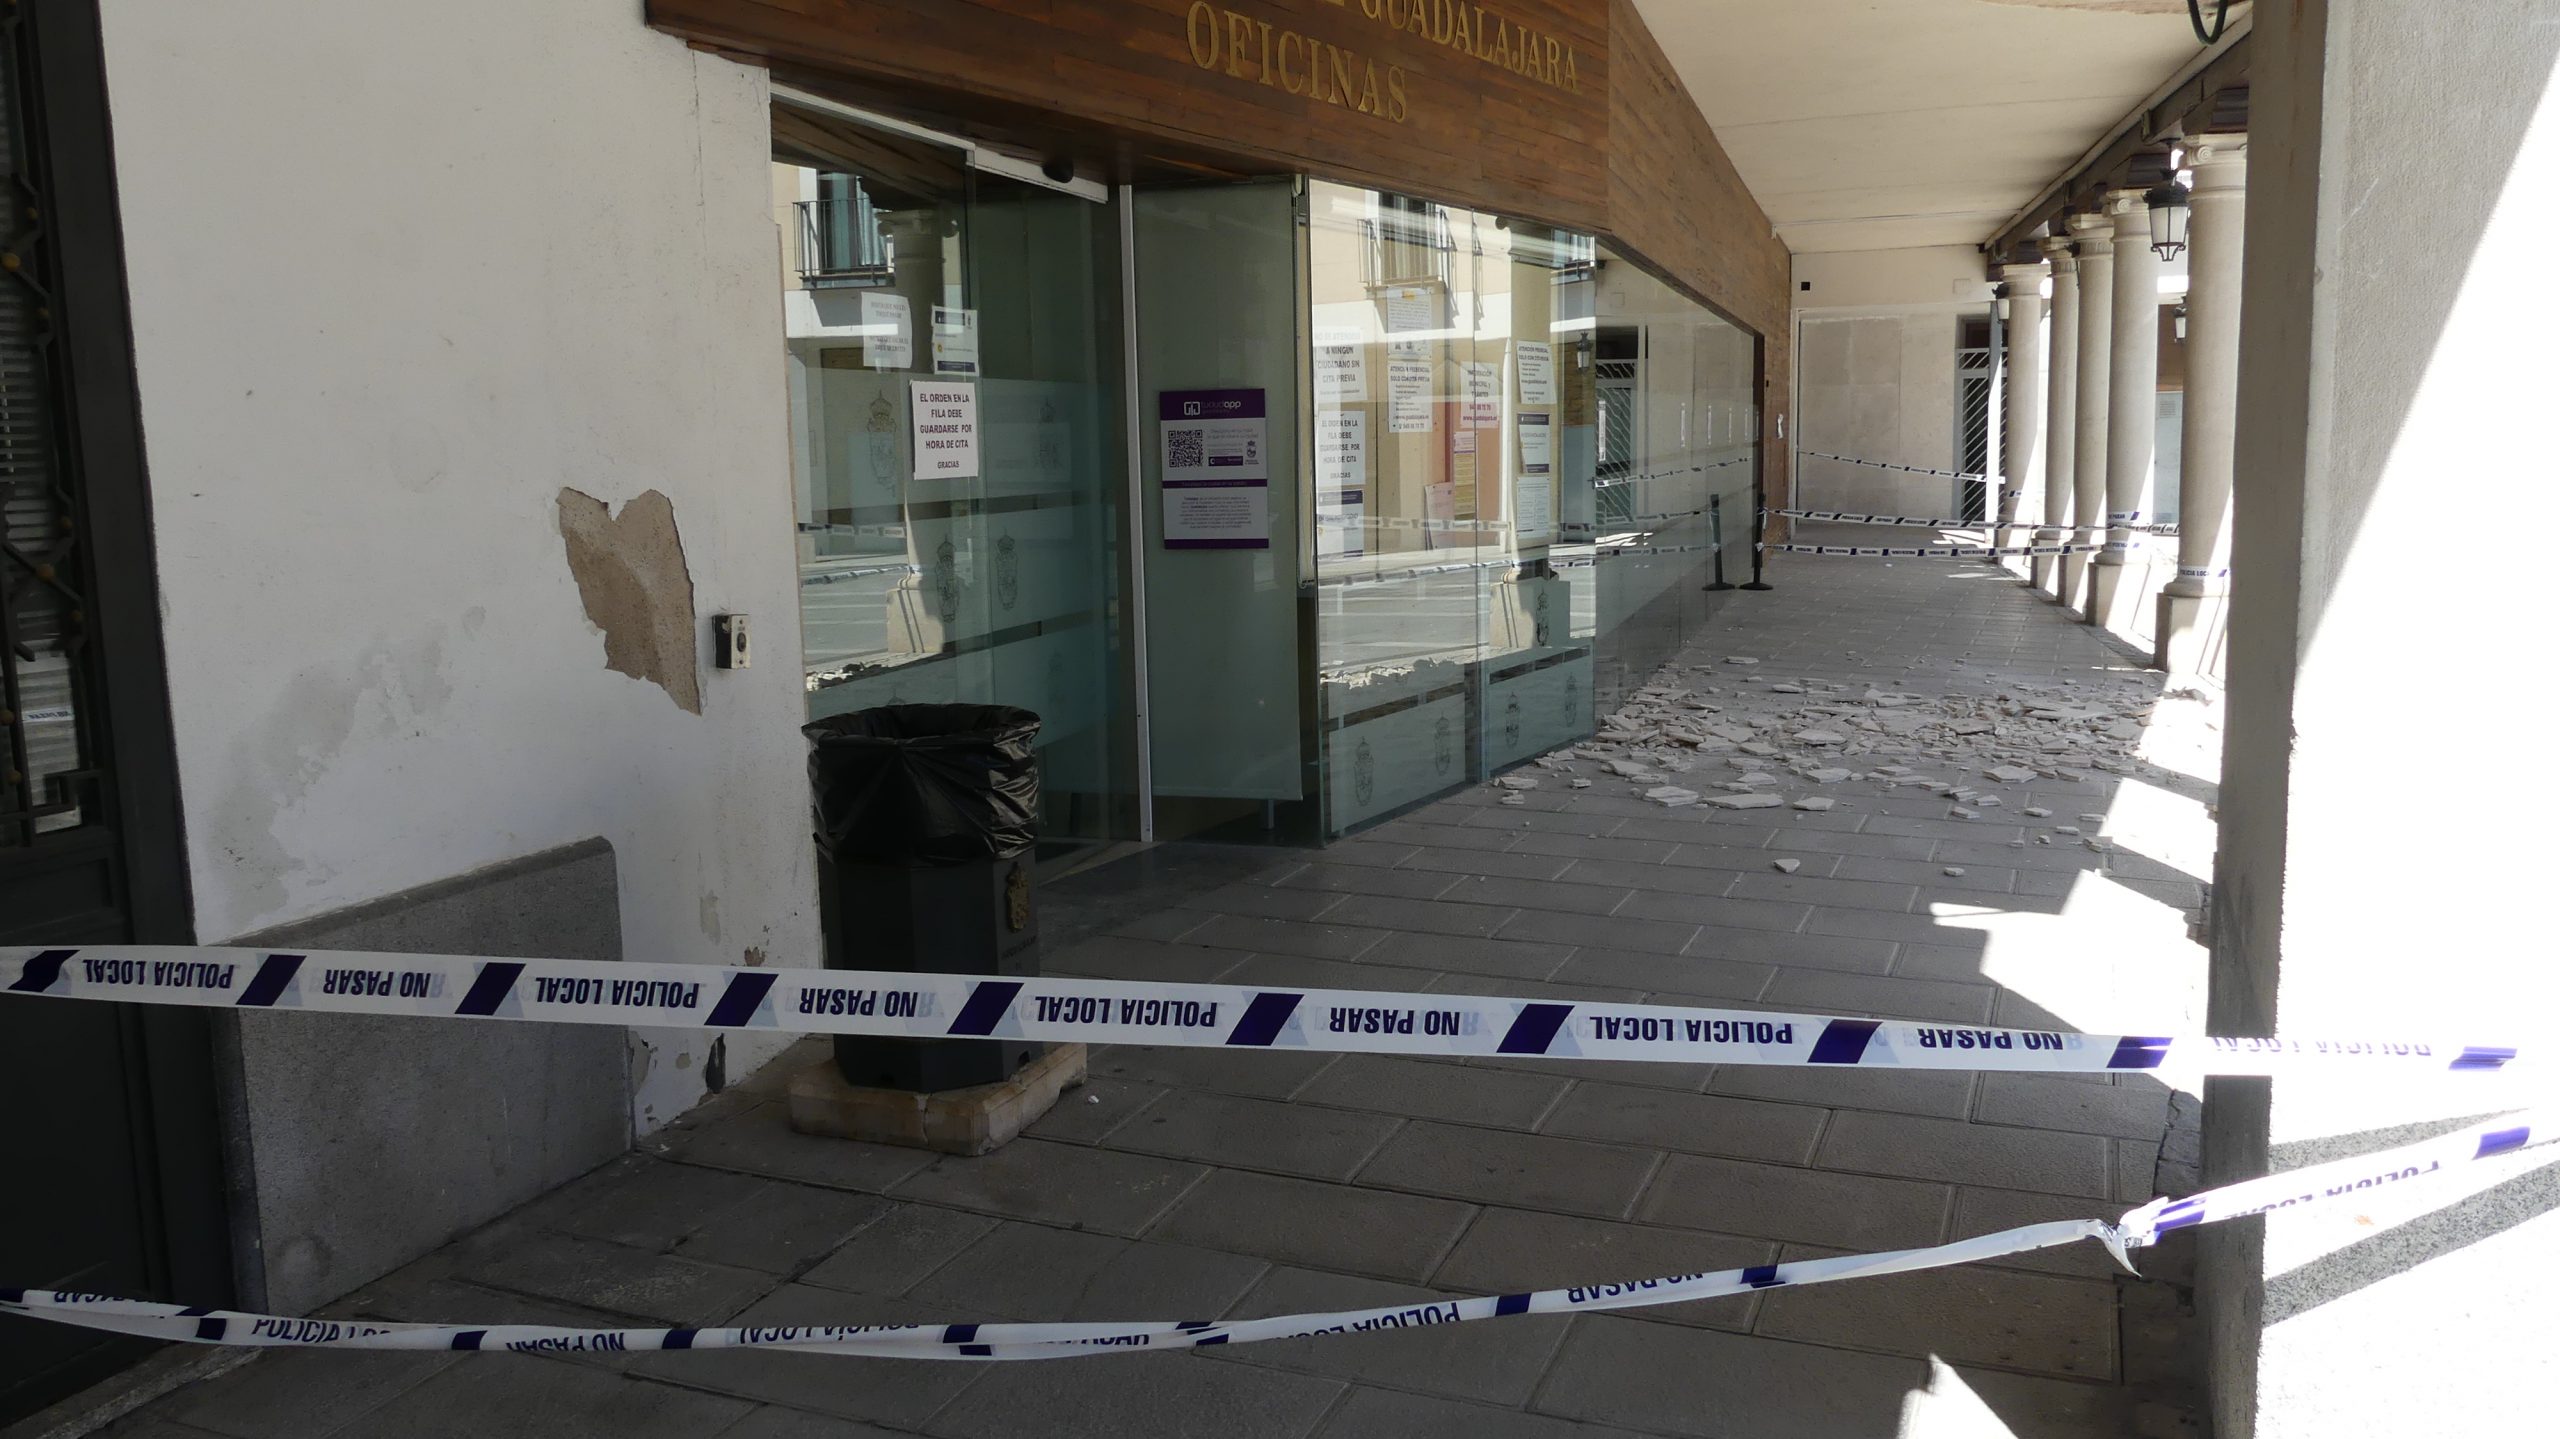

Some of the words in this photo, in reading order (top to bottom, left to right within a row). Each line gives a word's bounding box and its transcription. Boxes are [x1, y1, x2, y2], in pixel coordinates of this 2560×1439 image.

[1187, 0, 1407, 123] OFICINAS
[920, 393, 928, 403] EL
[930, 393, 952, 403] ORDEN
[954, 394, 962, 403] EN
[962, 394, 970, 403] LA
[931, 409, 946, 418] FILA
[947, 409, 962, 418] DEBE
[920, 424, 958, 434] GUARDARSE
[961, 424, 972, 433] POR
[926, 440, 945, 449] HORA
[946, 440, 954, 449] DE
[955, 439, 968, 449] CITA
[937, 461, 959, 469] GRACIAS
[82, 958, 147, 986] LOCAL
[154, 960, 235, 989] POLICIA
[322, 968, 398, 997] PASAR
[400, 972, 431, 998] NO
[535, 976, 603, 1005] LOCAL
[612, 979, 700, 1009] POLICIA
[801, 986, 877, 1017] PASAR
[883, 990, 918, 1018] NO
[1034, 995, 1110, 1025] LOCAL
[1119, 998, 1217, 1028] POLICIA
[1329, 1006, 1413, 1035] PASAR
[1423, 1010, 1460, 1036] NO
[1589, 1015, 1674, 1041] LOCAL
[1685, 1019, 1793, 1045] POLICIA
[1917, 1027, 2013, 1050] PASAR
[2021, 1031, 2064, 1051] NO
[1567, 1280, 1658, 1304] PASAR
[251, 1319, 340, 1343] POLICIA
[1352, 1302, 1461, 1334] POLICIA
[592, 1332, 625, 1351] NO
